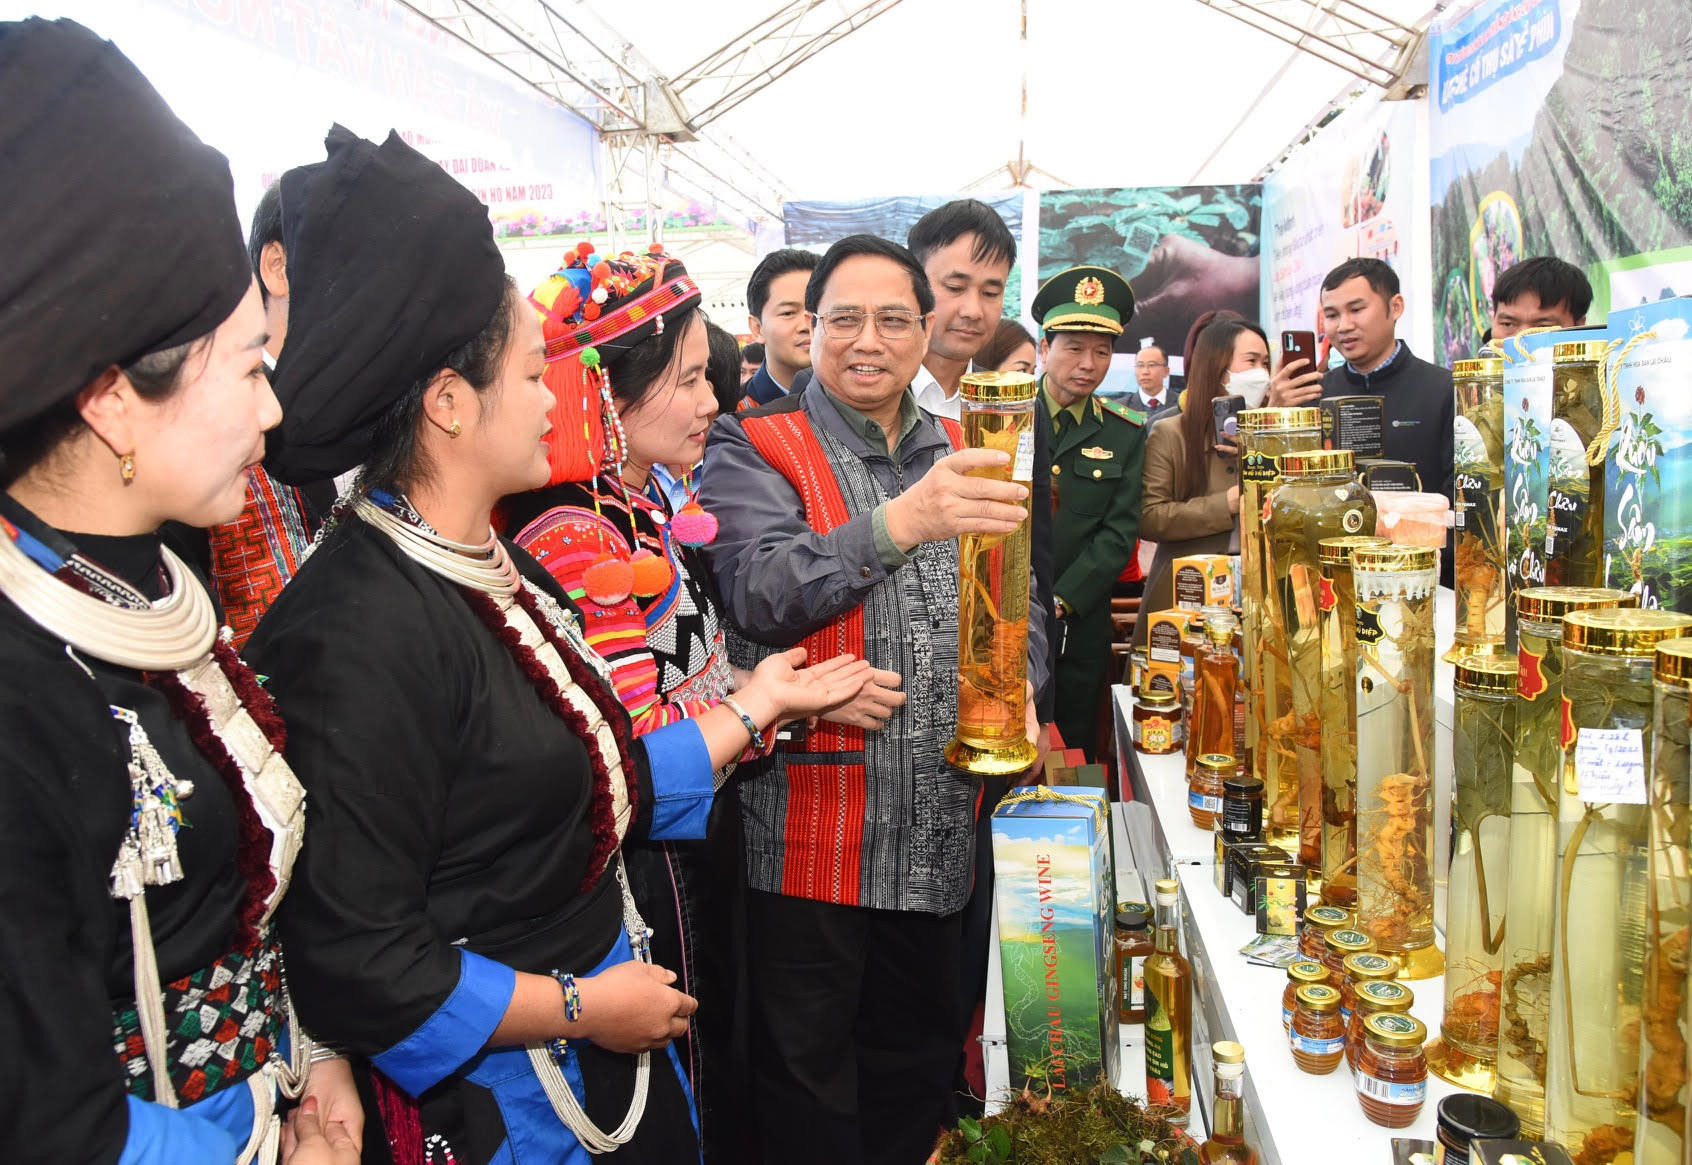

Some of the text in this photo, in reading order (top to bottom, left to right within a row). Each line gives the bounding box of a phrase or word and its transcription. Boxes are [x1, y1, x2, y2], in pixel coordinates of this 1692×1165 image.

[529, 183, 554, 201] 2023
[1036, 854, 1067, 1089] LAI CHAU GINGSENG WINE
